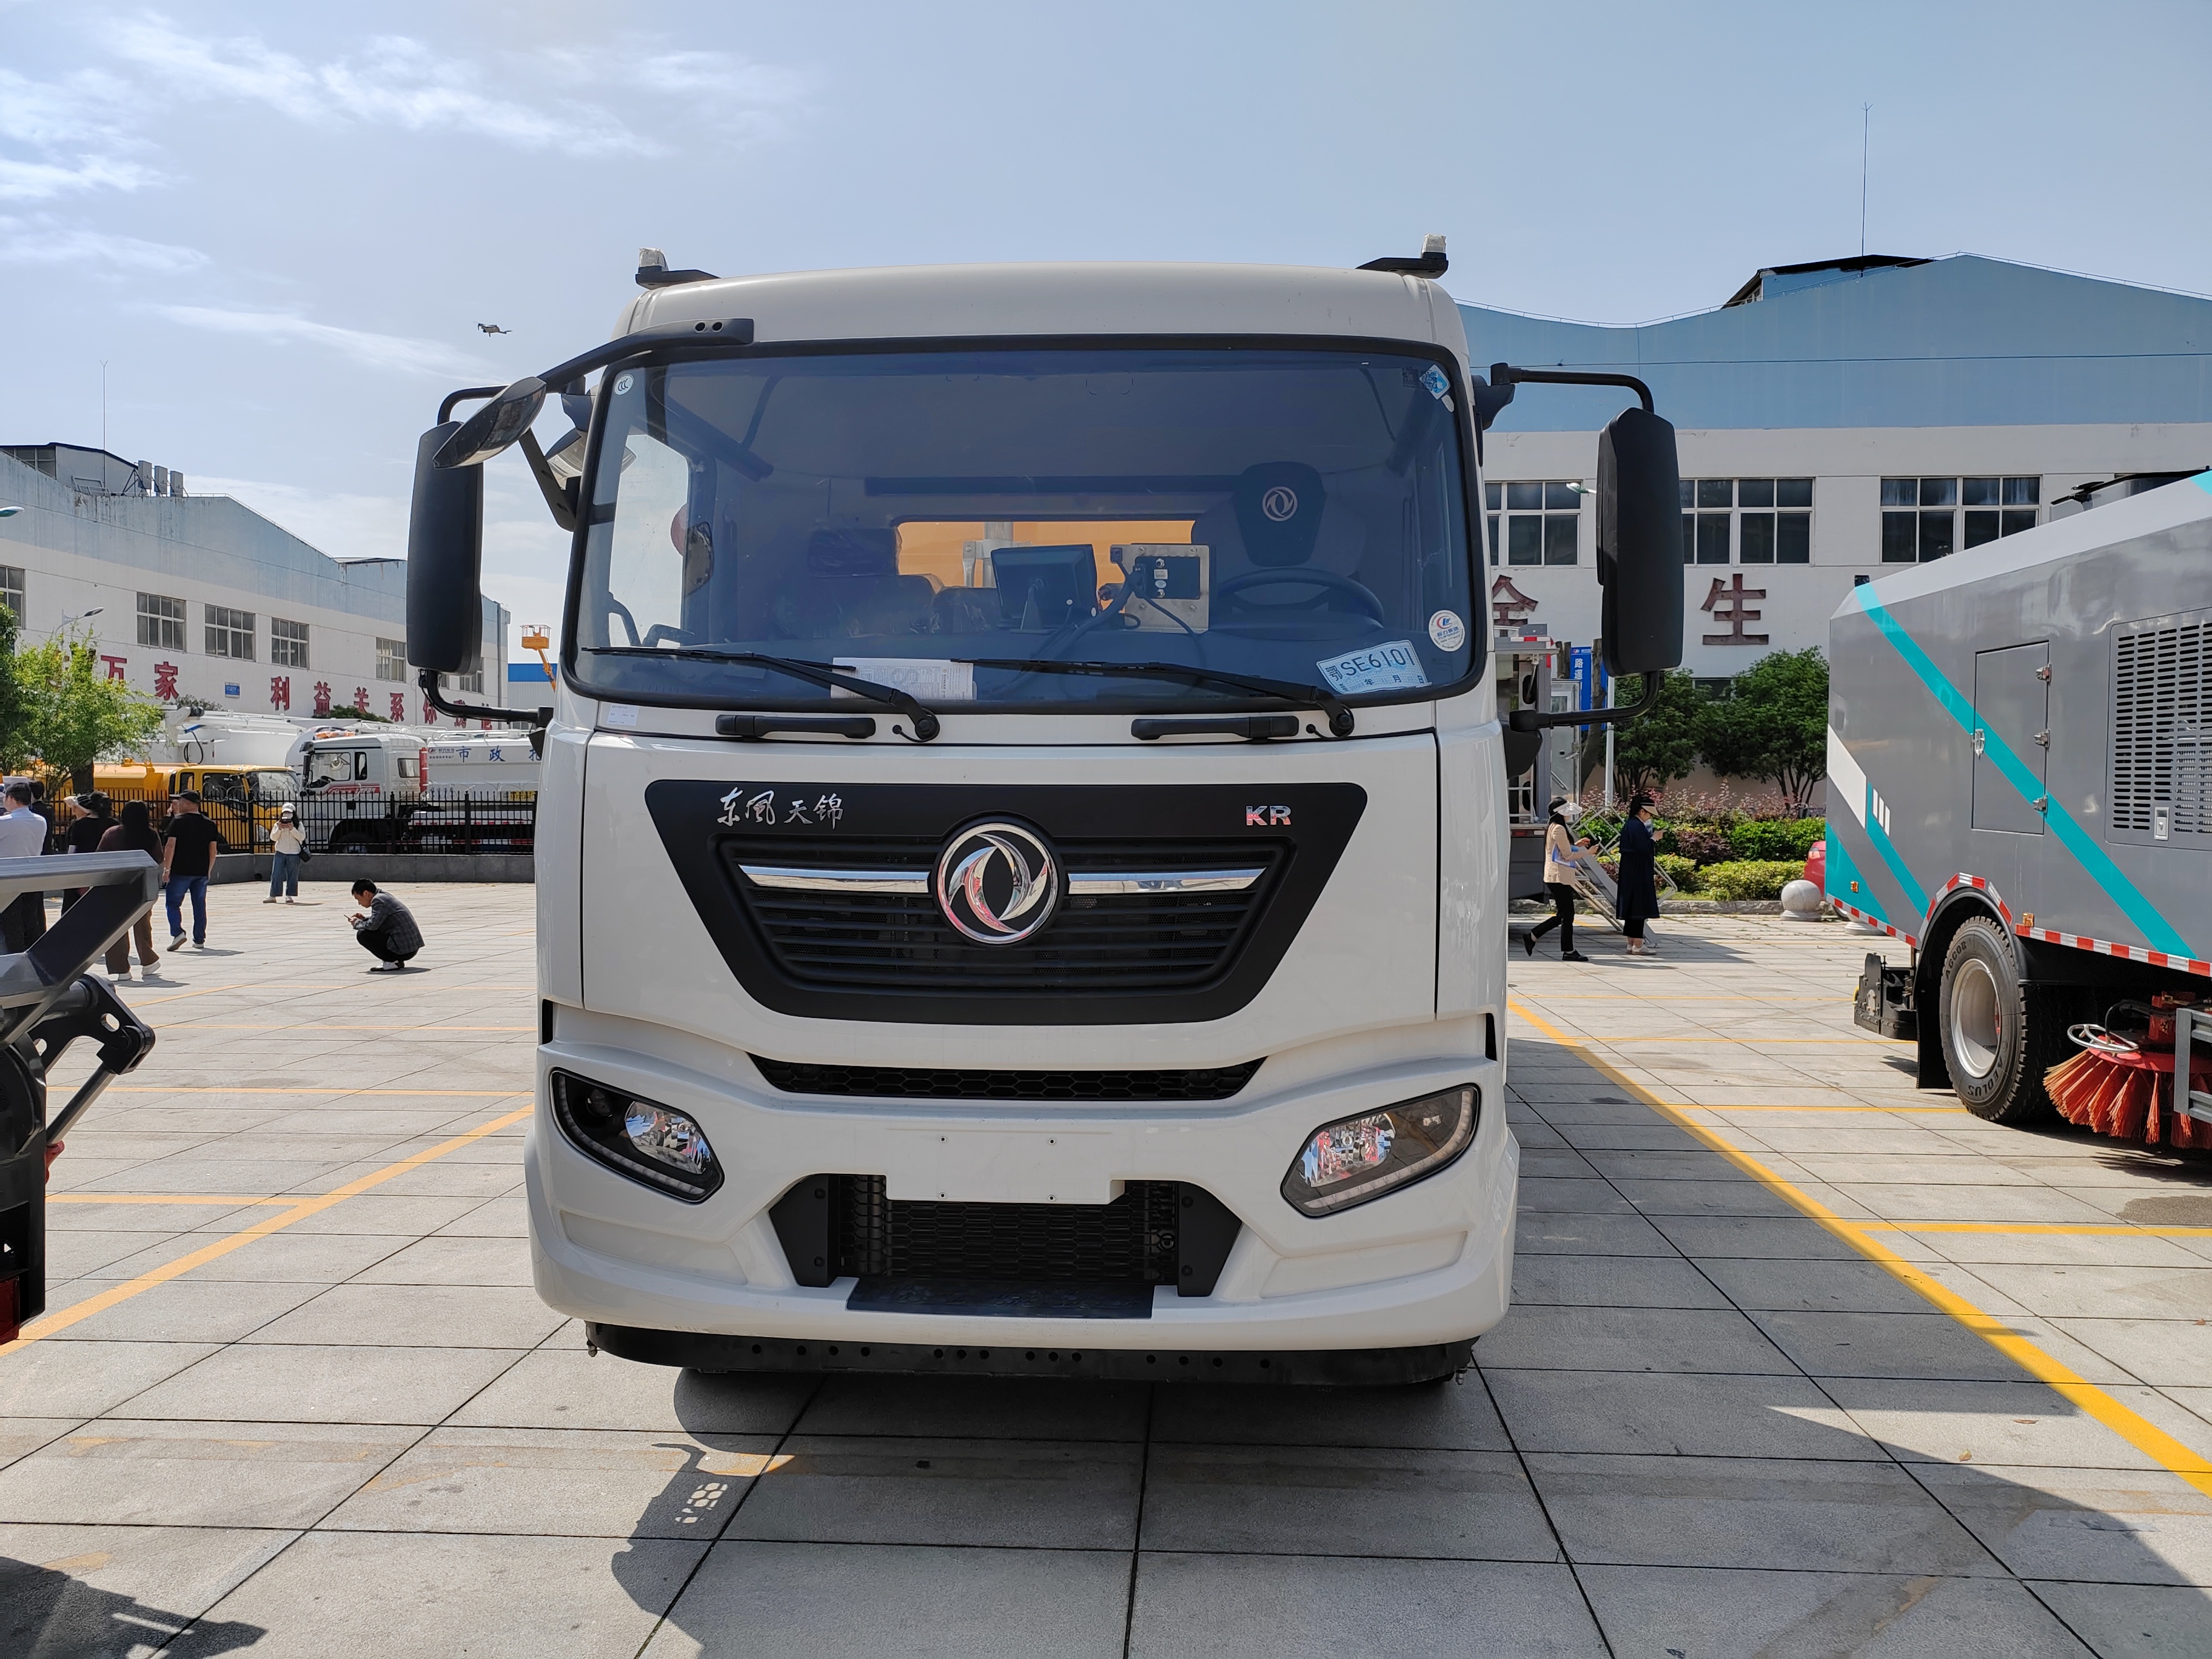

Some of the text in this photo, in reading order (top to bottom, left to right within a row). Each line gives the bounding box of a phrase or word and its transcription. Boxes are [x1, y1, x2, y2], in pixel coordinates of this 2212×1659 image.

[1701, 573, 1769, 645] 生
[1393, 674, 1402, 683] 月
[1245, 805, 1292, 826] KR
[1967, 1056, 2003, 1096] AEOLUS
